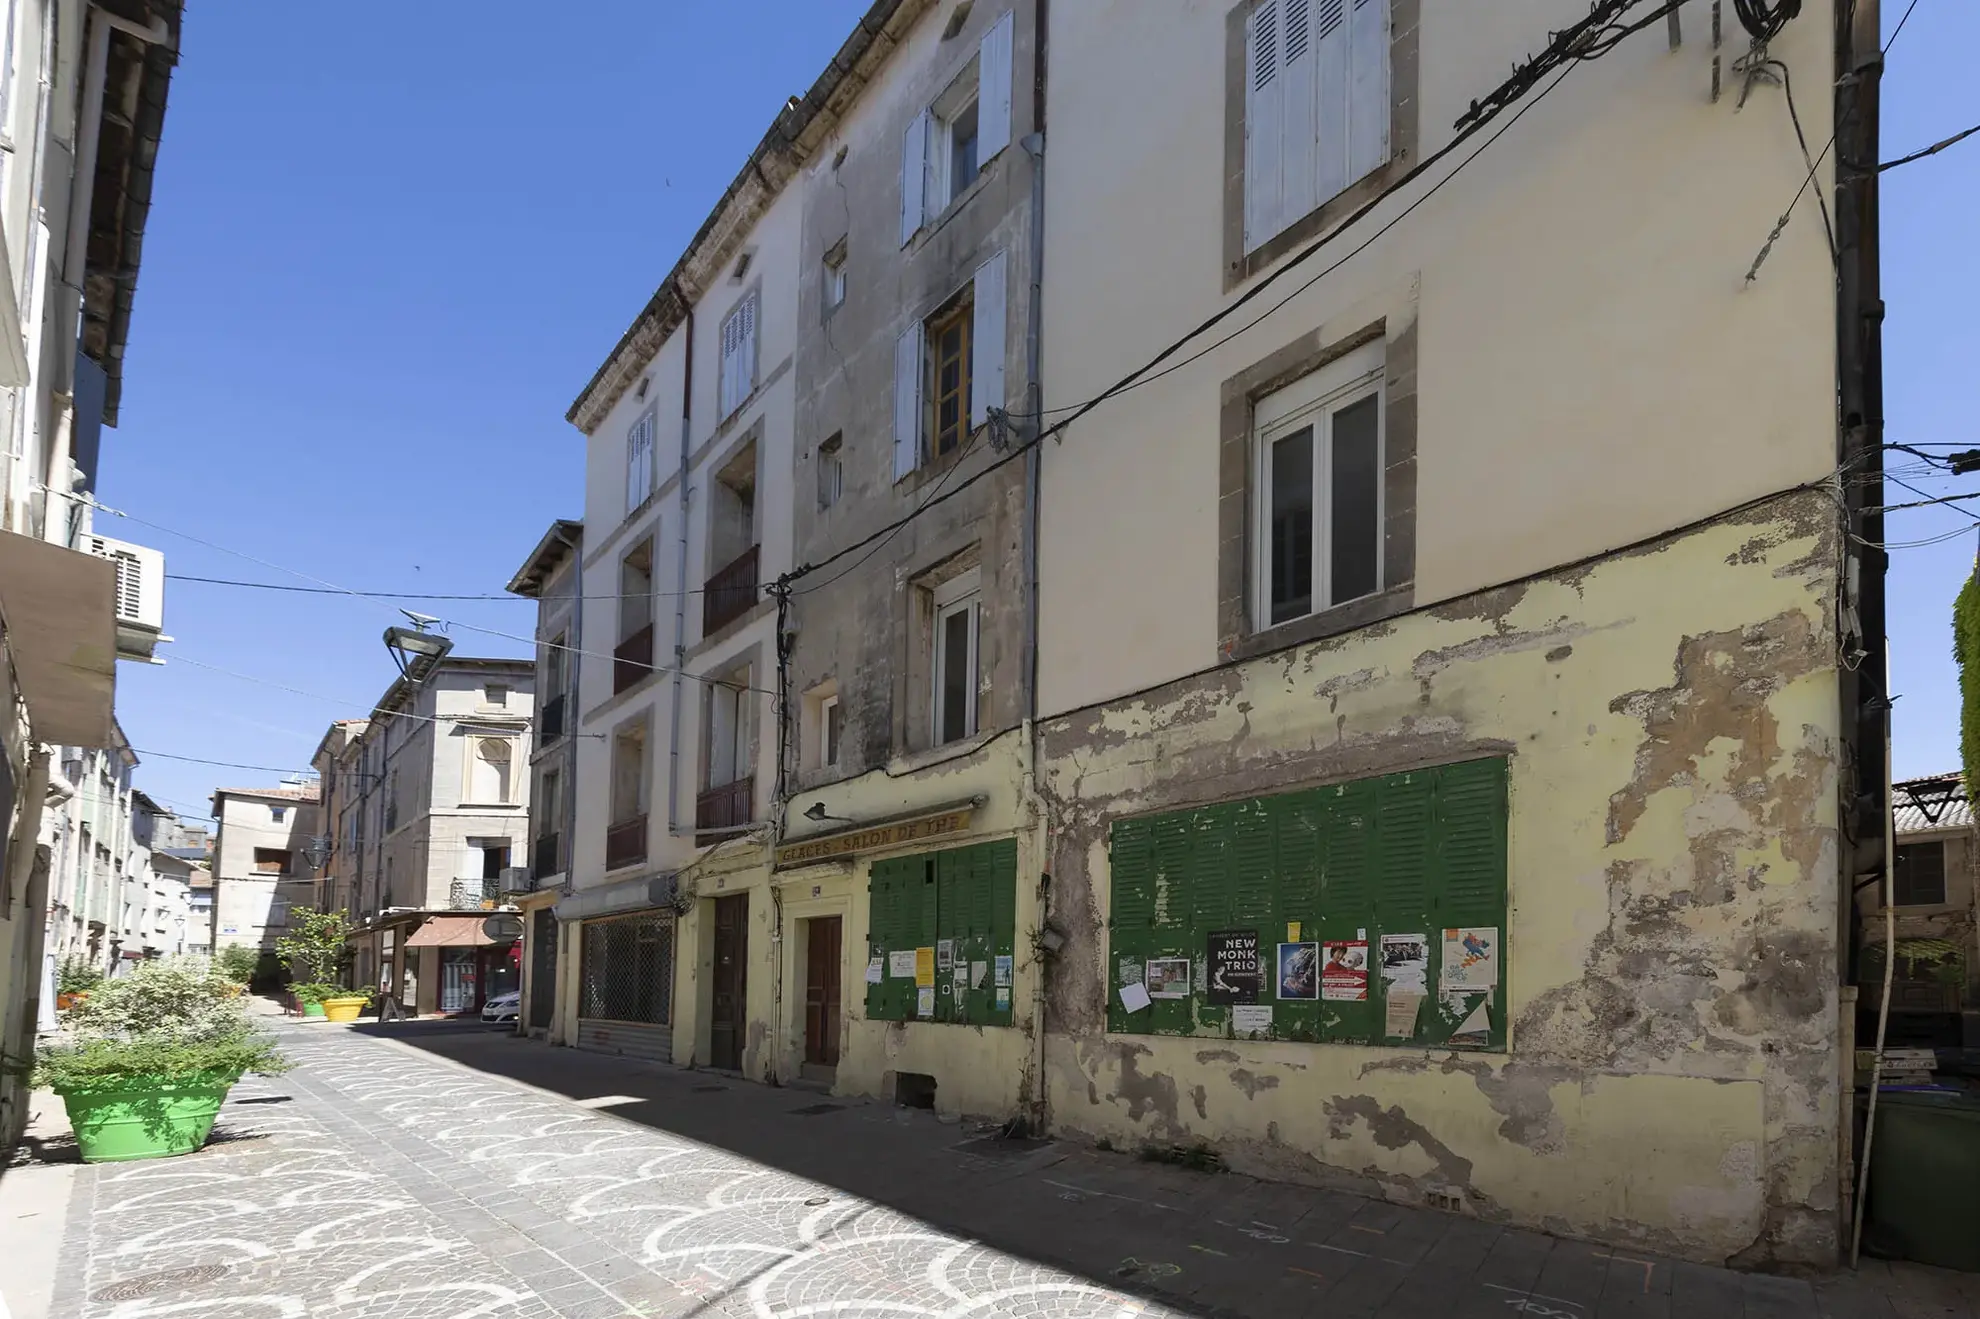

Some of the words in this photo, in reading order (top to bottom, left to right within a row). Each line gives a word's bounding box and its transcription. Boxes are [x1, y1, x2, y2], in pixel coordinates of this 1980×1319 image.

[782, 842, 831, 861] GLACES
[843, 828, 892, 851] SALON
[897, 824, 918, 840] DE
[1225, 938, 1256, 949] NEW
[1217, 949, 1256, 960] MONK
[1225, 960, 1256, 970] TRIO
